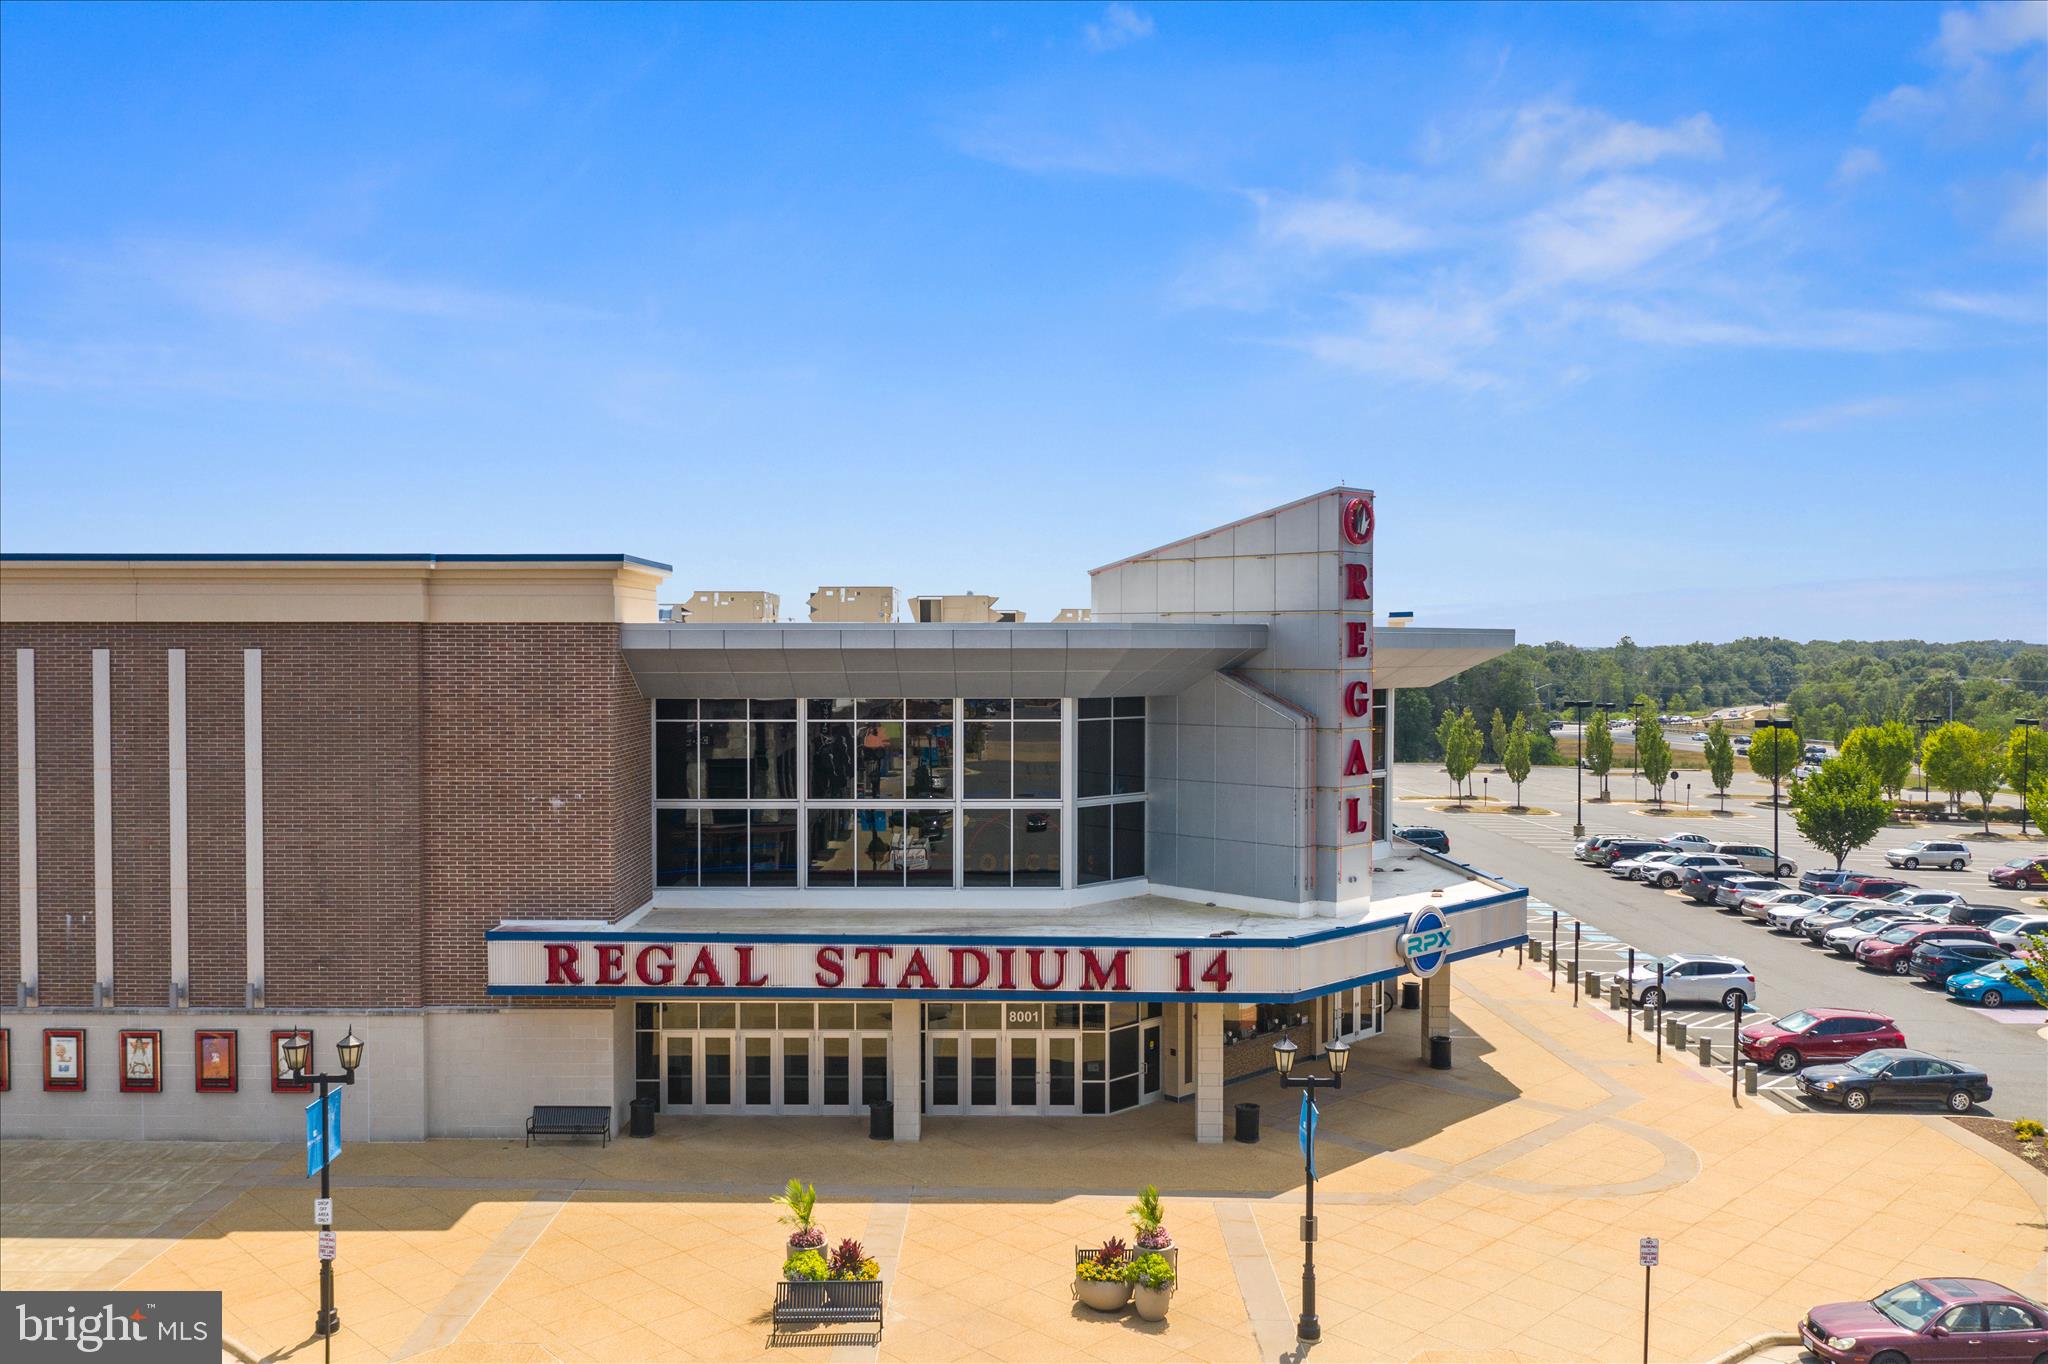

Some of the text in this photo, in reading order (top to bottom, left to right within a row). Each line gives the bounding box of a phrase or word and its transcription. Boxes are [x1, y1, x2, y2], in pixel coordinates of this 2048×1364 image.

[1343, 563, 1370, 834] REGAL
[1407, 929, 1452, 955] RPX
[546, 943, 1233, 993] REGAL STADIUM 14
[1009, 1011, 1038, 1023] 8001
